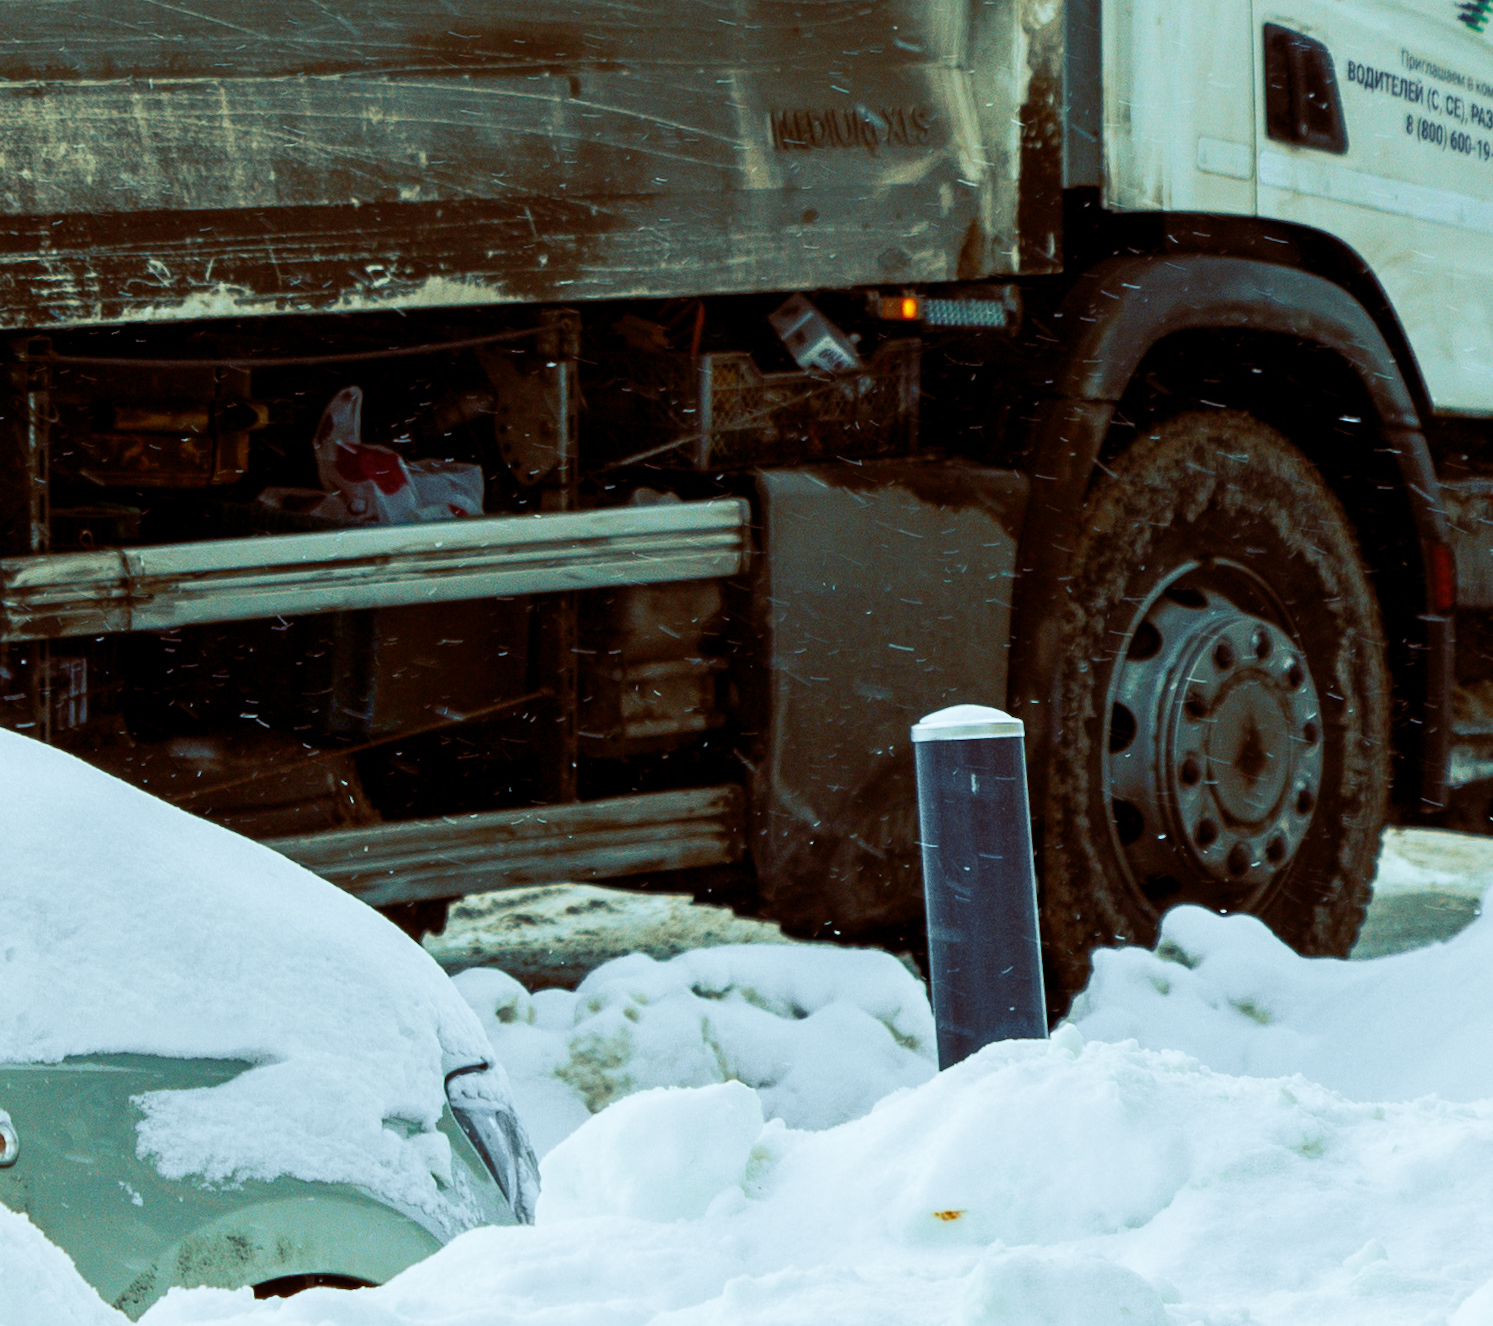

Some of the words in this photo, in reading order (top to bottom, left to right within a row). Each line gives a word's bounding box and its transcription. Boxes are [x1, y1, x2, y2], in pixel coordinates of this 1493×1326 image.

[1347, 59, 1424, 105] ВОДИТЕЛЕЙ
[1401, 47, 1465, 88] Приглашаем
[1466, 76, 1474, 92] в
[1405, 114, 1414, 135] 8
[1417, 118, 1448, 151] (800)
